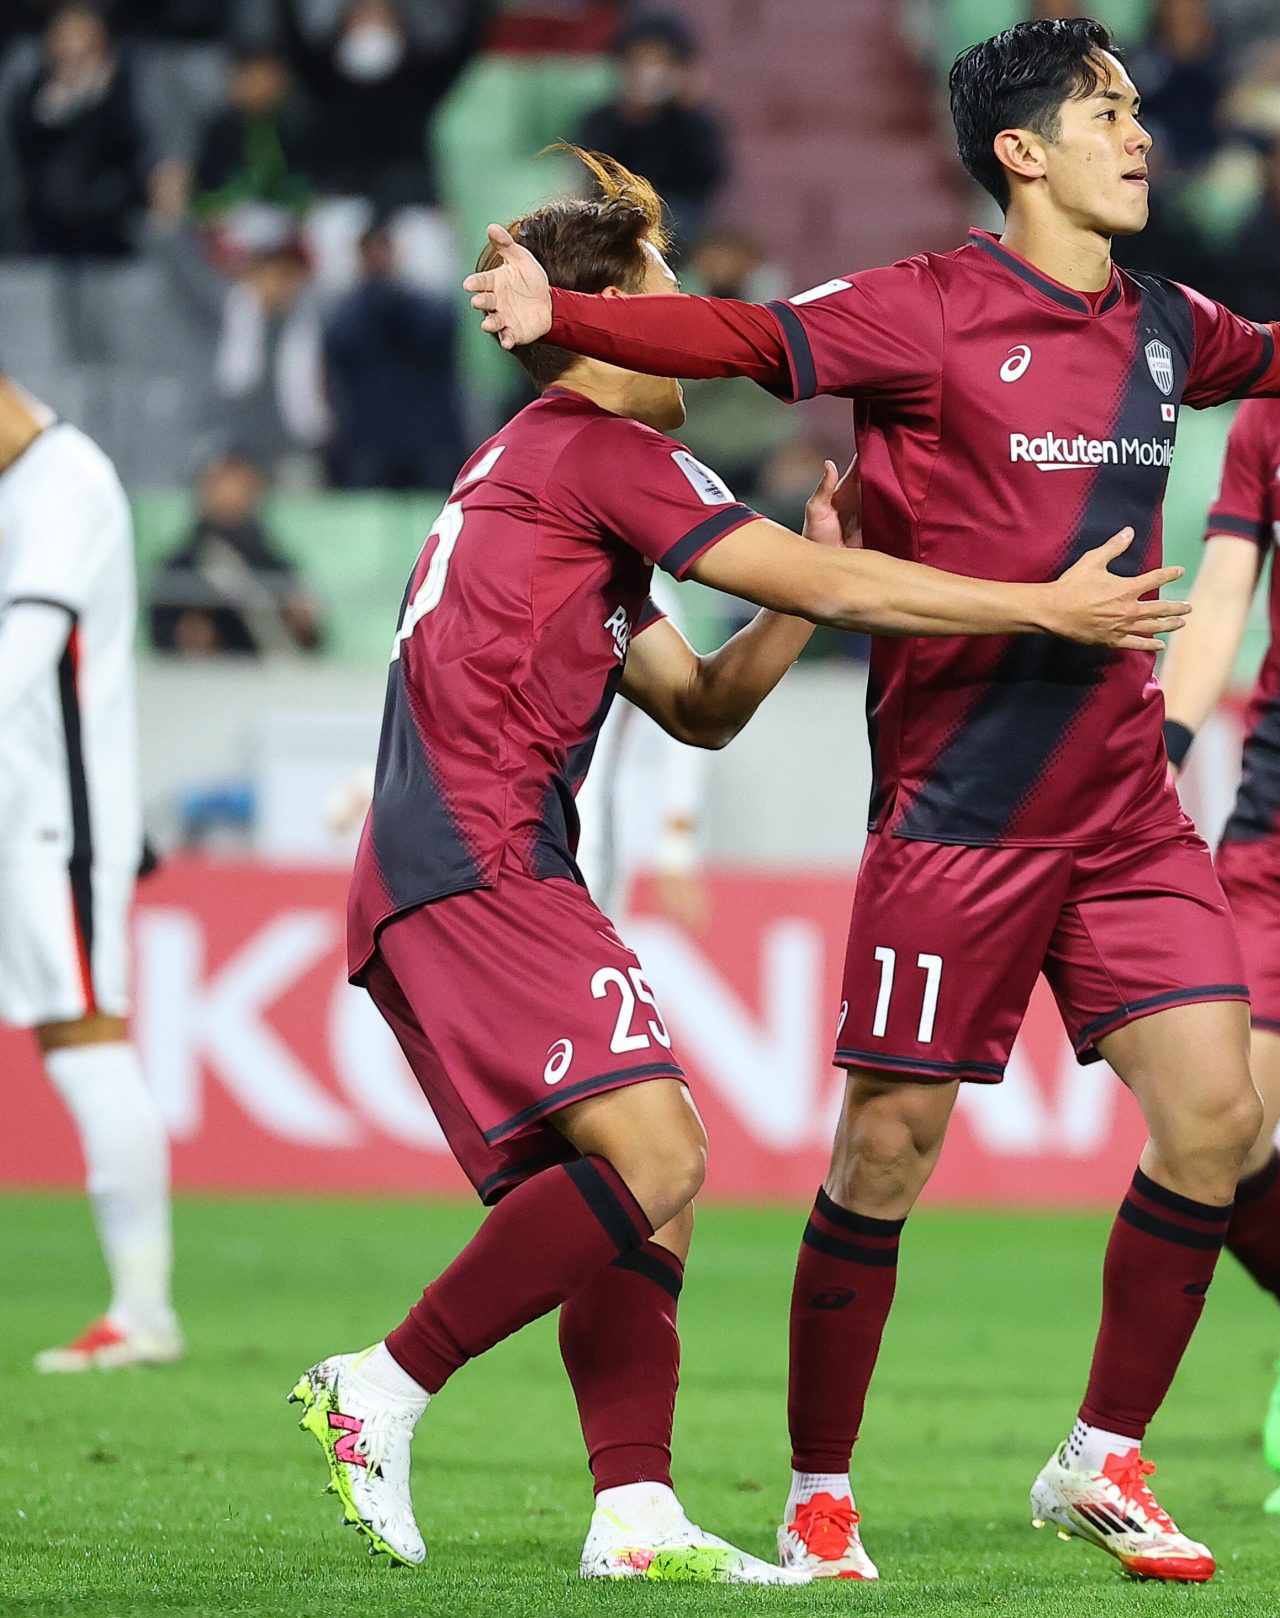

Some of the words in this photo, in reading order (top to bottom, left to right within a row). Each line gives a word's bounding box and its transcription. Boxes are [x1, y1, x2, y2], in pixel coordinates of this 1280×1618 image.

[1009, 431, 1118, 464] Rakuten
[590, 966, 671, 1054] 25
[872, 945, 943, 1043] 11
